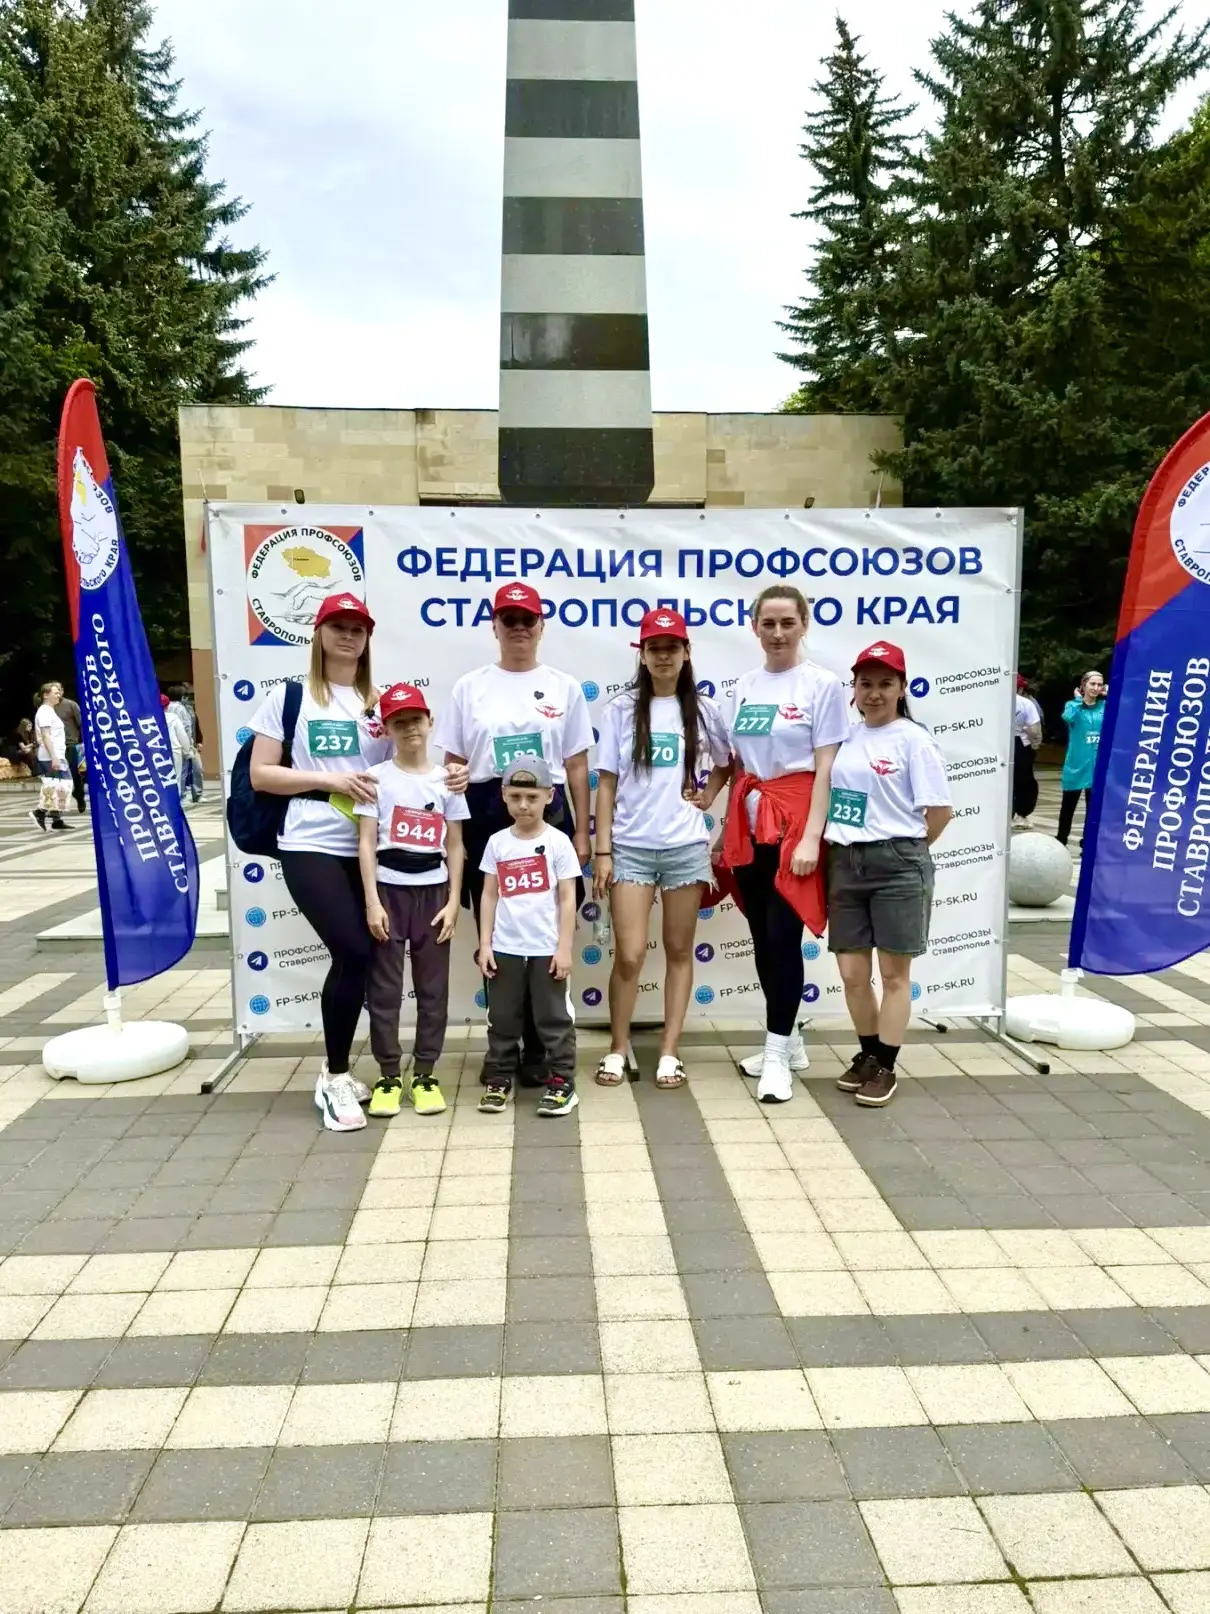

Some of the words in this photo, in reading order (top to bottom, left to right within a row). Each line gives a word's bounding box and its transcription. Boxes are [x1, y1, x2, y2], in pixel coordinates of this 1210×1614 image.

[251, 528, 298, 579] ФЕДЕРАЦИЯ
[301, 527, 362, 582] ПРОФСОЮЗОВ
[397, 546, 663, 583] ФЕДЕРАЦИЯ
[678, 547, 983, 578] ПРОФСОЮЗОВ
[857, 595, 959, 625] КРАЯ
[935, 665, 1001, 685] ПРОФСОЮЗЫ
[940, 678, 1000, 695] Ставрополья
[737, 717, 769, 731] 277
[933, 717, 984, 735] FP-SK.RU
[138, 715, 177, 789] КРАЯ
[315, 735, 353, 751] 237
[86, 655, 160, 862] ПРОФСОЮЗОВ
[92, 613, 189, 893] СТАВРОПОЛЬСКОГО
[651, 746, 674, 762] 70
[1122, 669, 1173, 850] ФЕДЕРАЦИЯ
[946, 755, 998, 772] ОФСОЮЗЫ
[1153, 657, 1210, 872] ПРОФСОЮЗОВ
[947, 767, 996, 781] аврополья
[833, 803, 862, 823] 232
[396, 822, 436, 842] 944
[504, 871, 544, 891] 945
[927, 928, 992, 947] ПРОФСОЮЗЫ
[273, 943, 327, 959] ПРОФСОЮ
[932, 939, 991, 956] Ставрополья
[279, 953, 330, 968] Ставропол
[719, 982, 761, 998] FP-SK.R
[926, 976, 975, 994] FP-SK.RU
